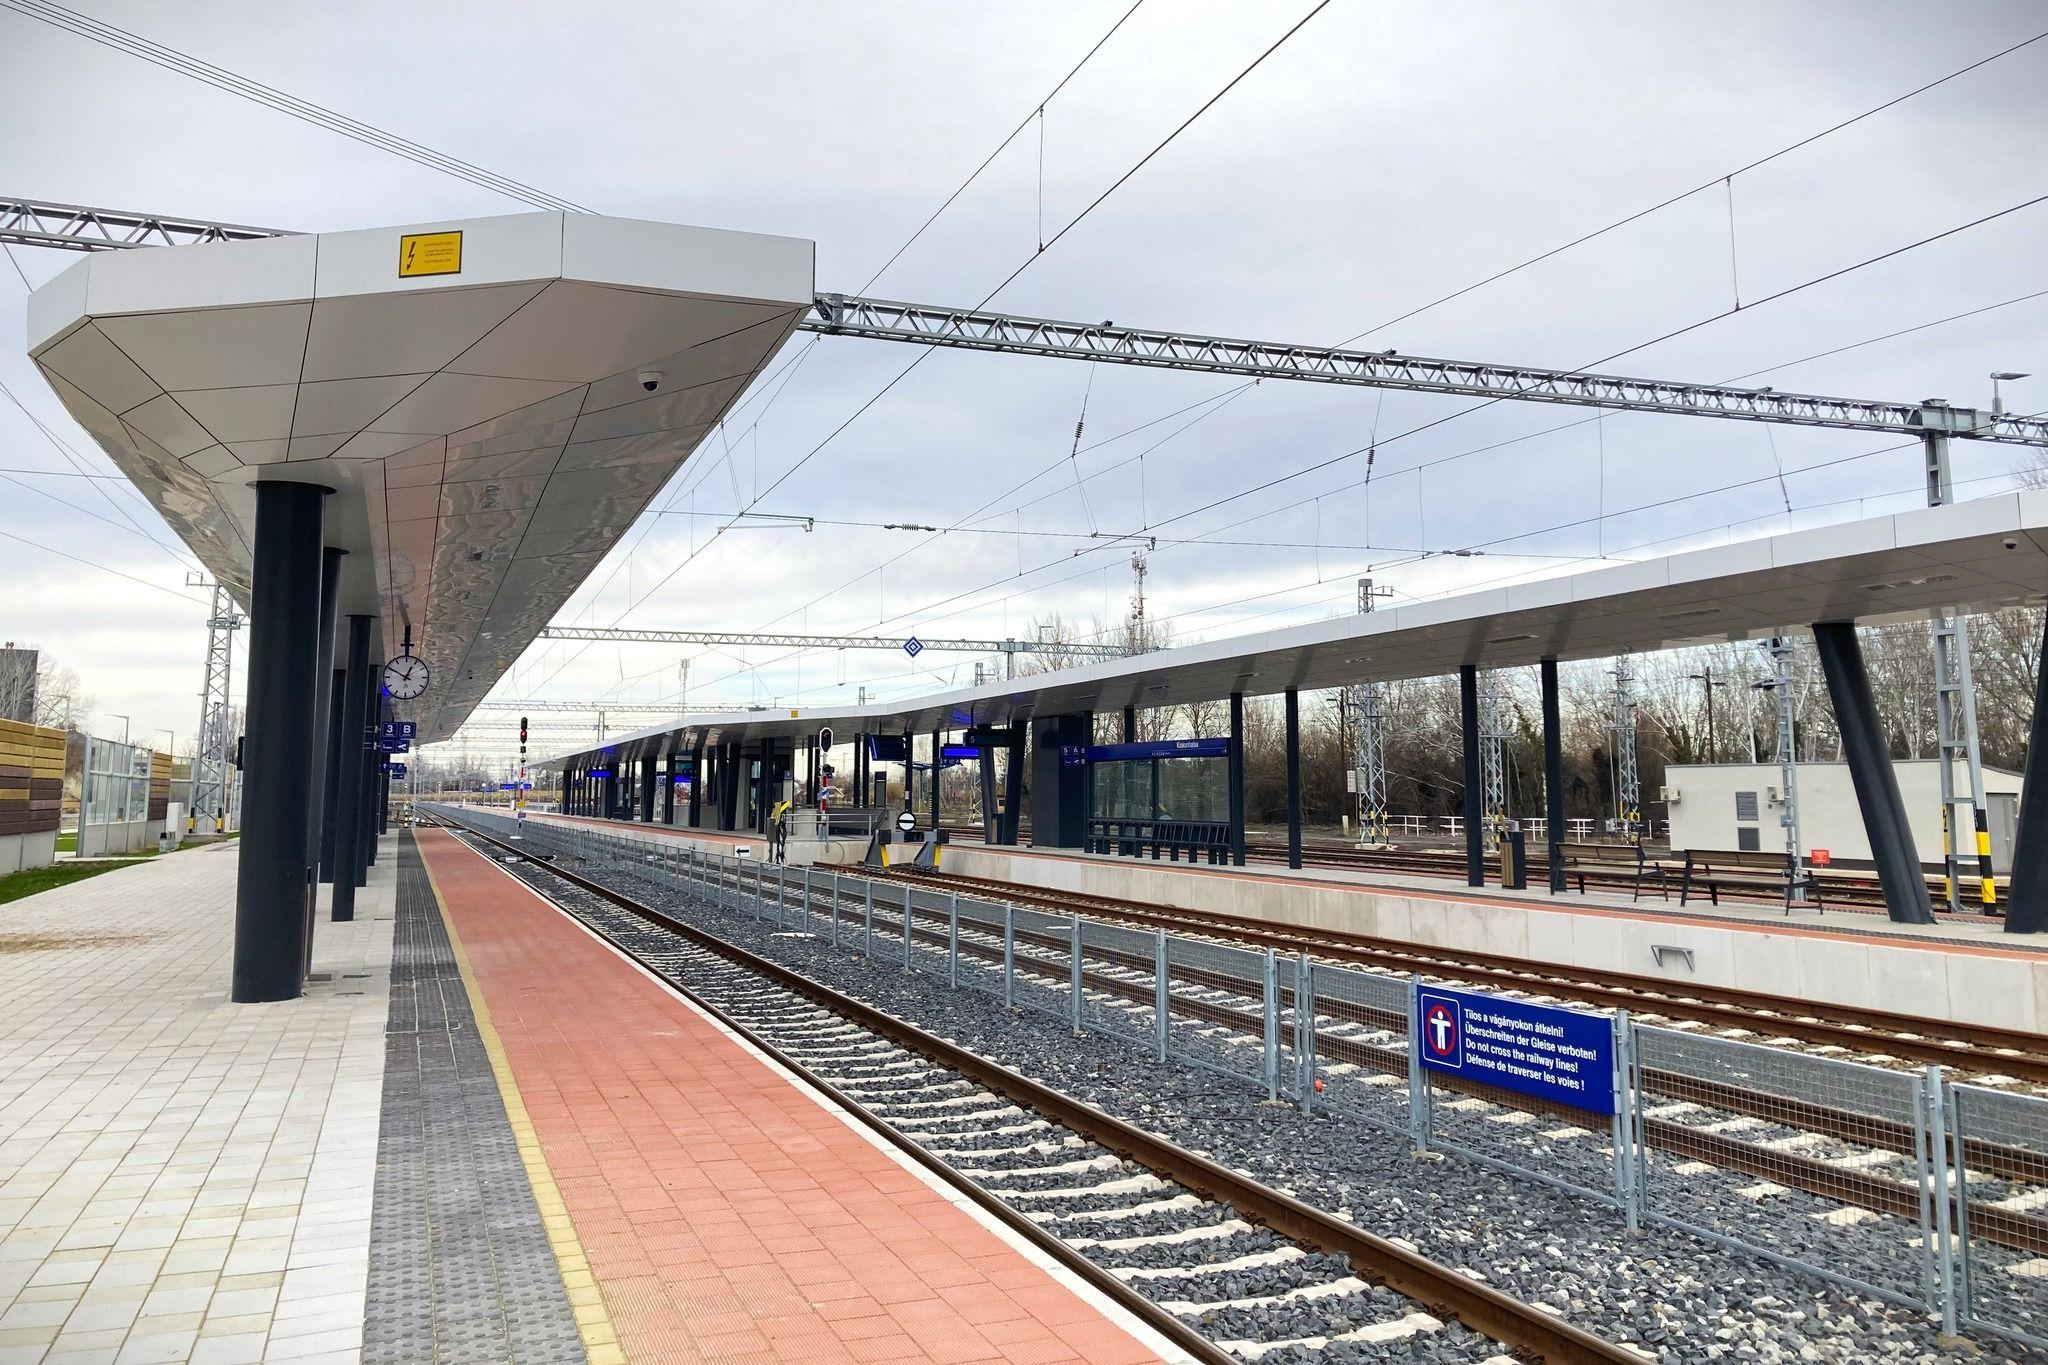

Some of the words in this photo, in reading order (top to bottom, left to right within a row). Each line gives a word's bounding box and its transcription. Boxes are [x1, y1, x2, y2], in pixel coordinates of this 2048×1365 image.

[386, 724, 393, 733] 3
[403, 724, 411, 733] B
[970, 735, 976, 743] 5
[1464, 1008, 1482, 1023] Tilos
[1489, 1014, 1533, 1031] vágányokon
[1535, 1023, 1564, 1038] átkelni!
[1465, 1022, 1515, 1044] Überschreiten
[1517, 1035, 1529, 1046] der
[1531, 1038, 1556, 1051] Gleise
[1557, 1044, 1597, 1061] verboten!
[1466, 1039, 1476, 1049] Do
[1477, 1043, 1489, 1053] not
[1491, 1046, 1511, 1057] cross
[1513, 1049, 1525, 1060] the
[1527, 1053, 1554, 1069] railway
[1556, 1058, 1578, 1073] lines!
[1467, 1053, 1495, 1069] Défense
[1497, 1061, 1506, 1071] de
[1508, 1063, 1542, 1081] traverser
[1544, 1071, 1555, 1083] les
[1557, 1076, 1579, 1090] voies
